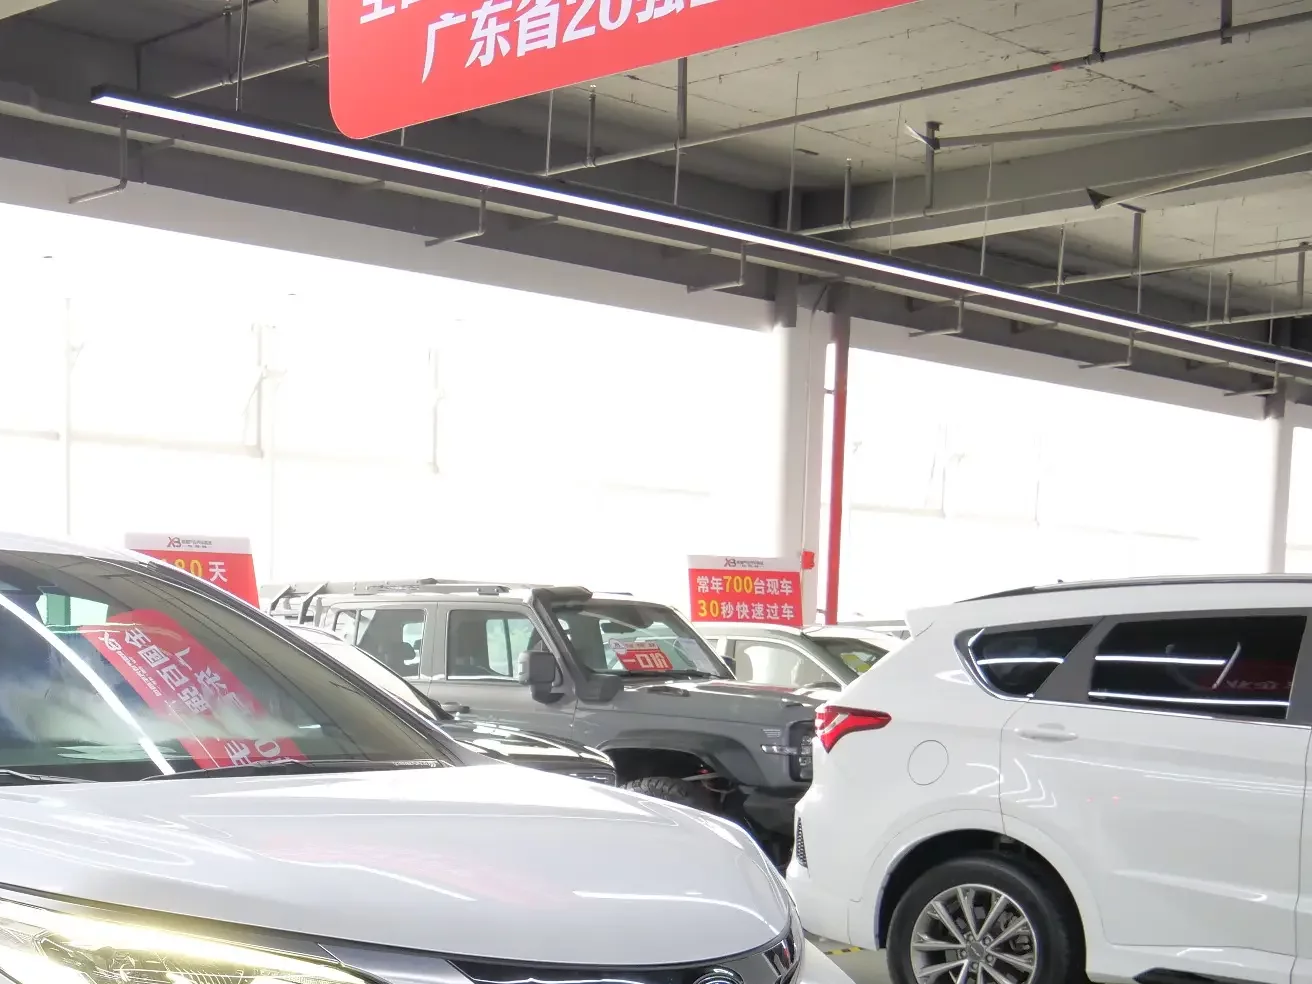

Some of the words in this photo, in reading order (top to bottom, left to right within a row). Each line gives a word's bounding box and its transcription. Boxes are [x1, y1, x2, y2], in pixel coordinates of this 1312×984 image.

[421, 0, 718, 84] 广东省20
[696, 575, 793, 596] 常年700台现车
[698, 599, 795, 620] 30秒快速过车
[622, 652, 669, 669] 一口价
